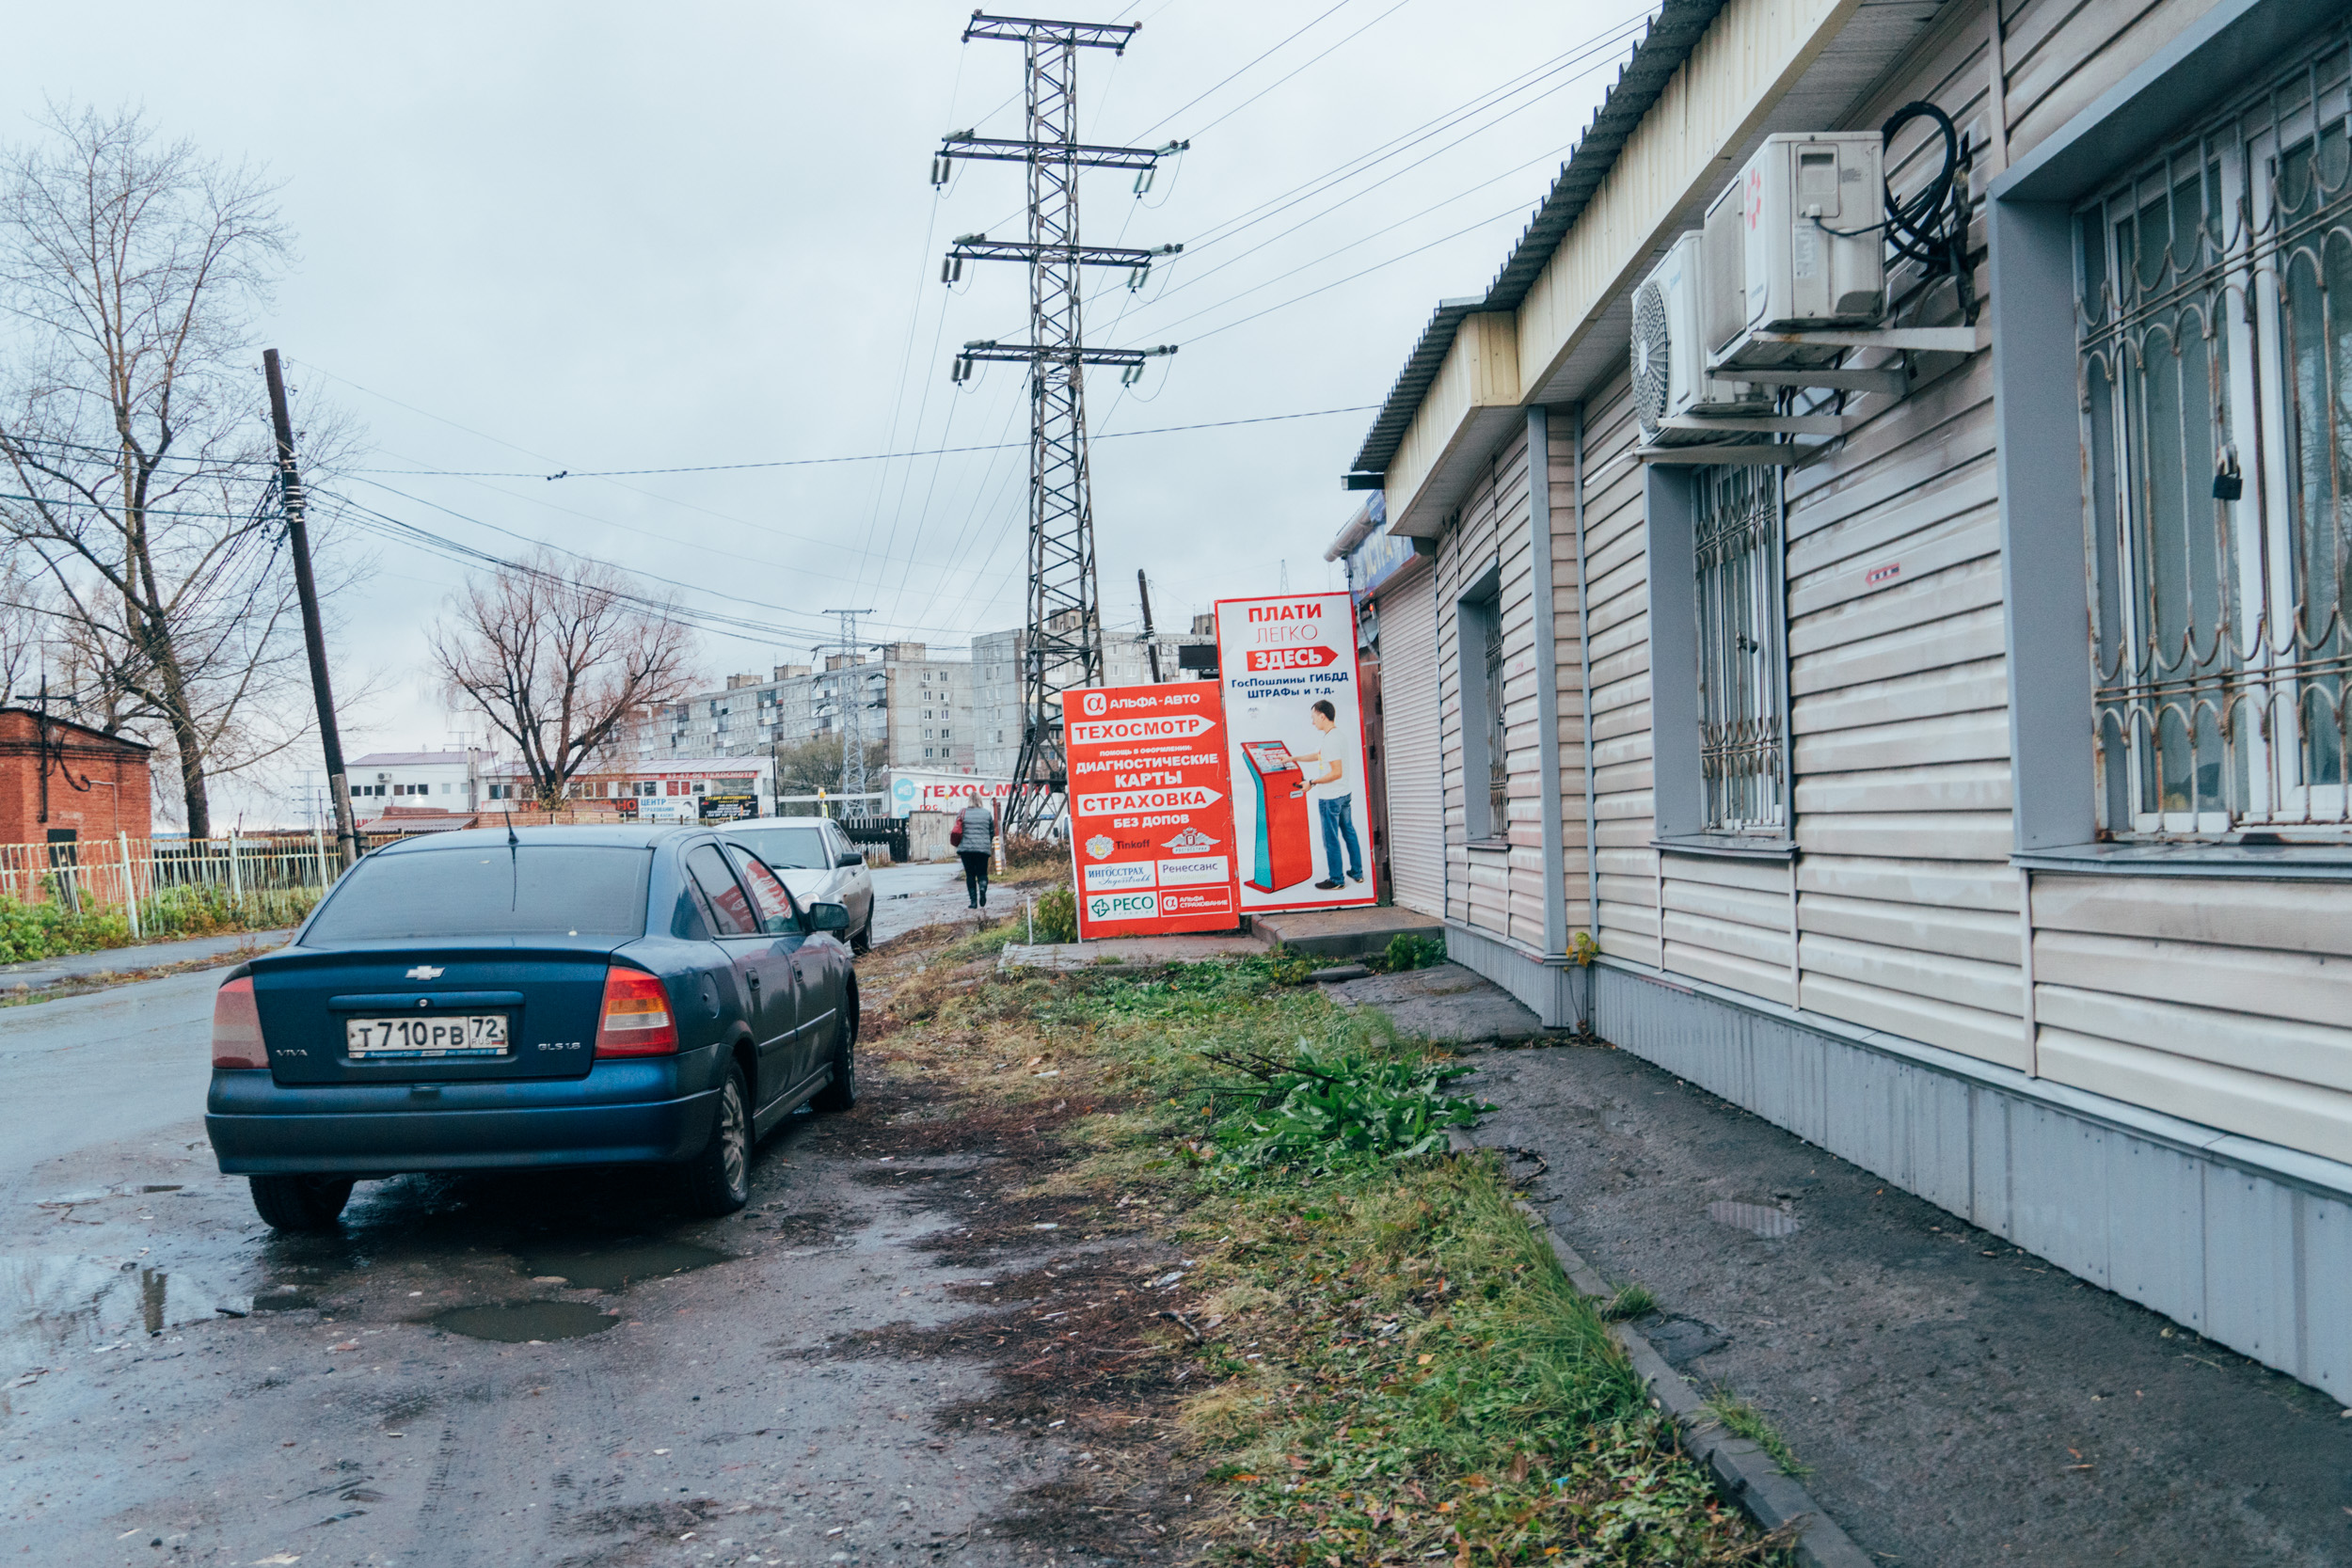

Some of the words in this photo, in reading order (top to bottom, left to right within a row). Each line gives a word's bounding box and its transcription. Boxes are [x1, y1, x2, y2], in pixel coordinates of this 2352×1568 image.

[1248, 604, 1322, 623] ПЛАТИ
[1256, 625, 1317, 643] ЛЕГКО
[1255, 649, 1323, 670] ЗДЕСЬ
[1232, 677, 1305, 688] ГосПошлины
[1310, 672, 1348, 683] ГИБДД
[1248, 688, 1299, 699] ШТРАФы
[1075, 719, 1200, 739] ТЕХОСМОТР
[1099, 749, 1132, 757] ПОМОЩЬ
[1075, 753, 1218, 774] ДИАГНОСТИЧЕСКИЕ
[1115, 770, 1183, 788] КАРТЫ
[1083, 791, 1207, 812] СТРАХОВКА
[1113, 817, 1139, 829] БЕЗ
[1142, 814, 1190, 828] ДОПОВ
[1115, 839, 1150, 849] Tinkoff
[1089, 866, 1144, 879] ИНГОССТРАХ
[1163, 863, 1217, 873] Ренессанс
[1113, 896, 1154, 911] РЕСО
[1180, 899, 1228, 909] СТРАХОВАНИЕ
[471, 1019, 498, 1037] 72
